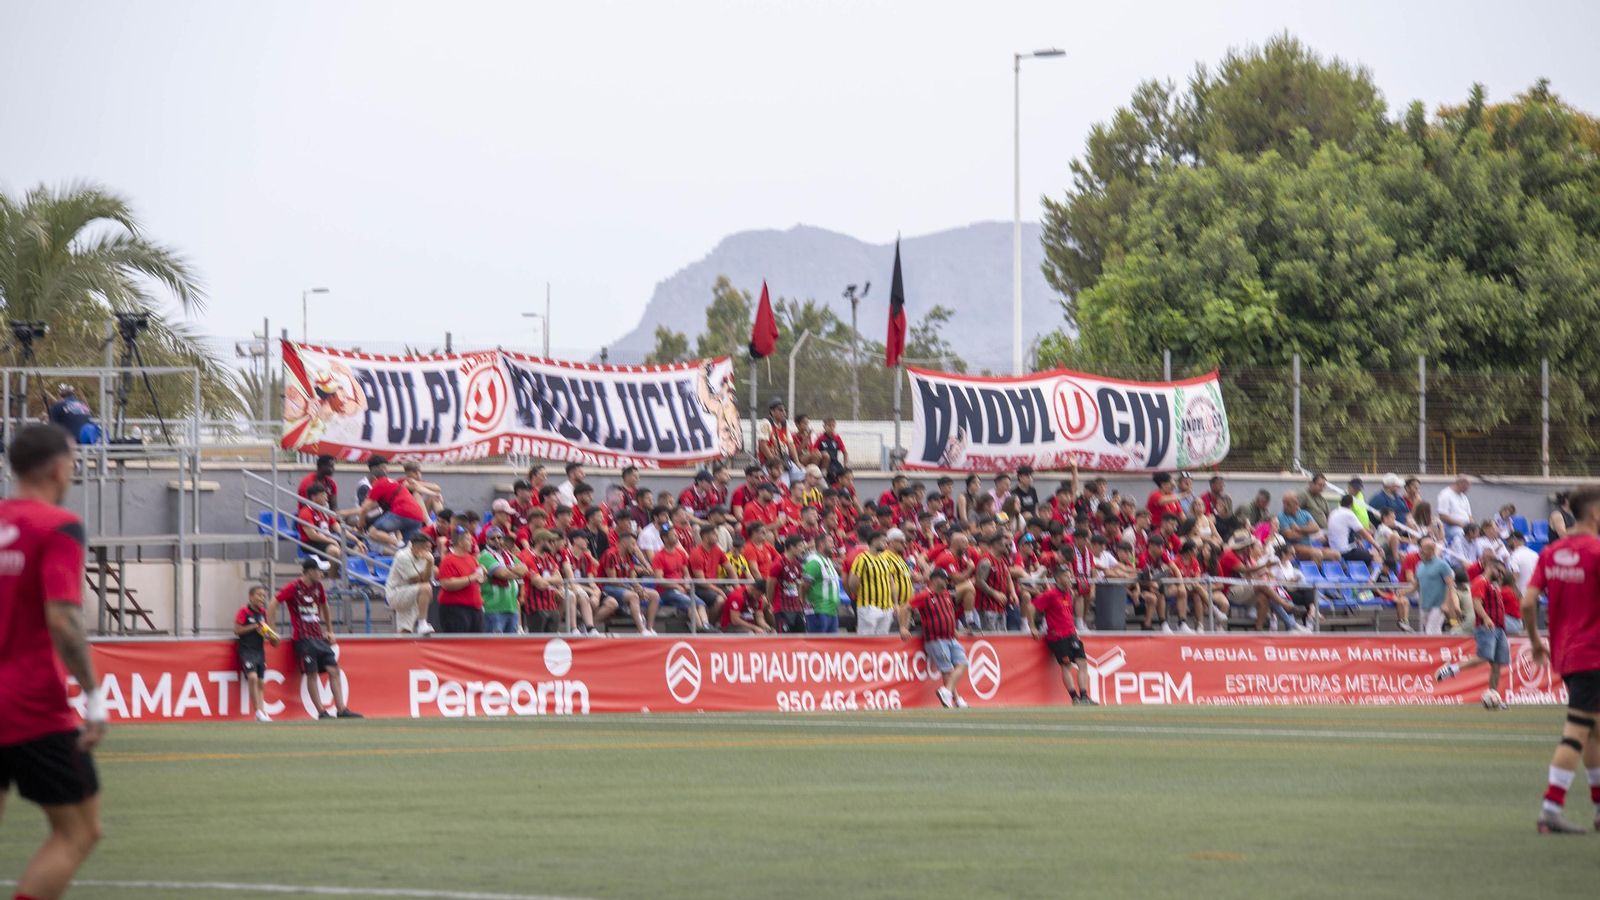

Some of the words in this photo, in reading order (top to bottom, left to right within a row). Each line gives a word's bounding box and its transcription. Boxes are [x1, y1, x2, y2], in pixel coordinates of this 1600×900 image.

[355, 367, 462, 444] PULPI
[710, 650, 942, 685] PULPIAUTOMOCION.CO
[1180, 645, 1258, 662] PASCUAL
[1264, 646, 1341, 662] GUEVARA
[1114, 671, 1194, 705] PGM
[1225, 673, 1342, 694] ESTRUCTURAS
[1346, 673, 1434, 694] METALICAS
[776, 689, 815, 712] 950
[820, 689, 857, 712] 464
[863, 689, 902, 711] 306
